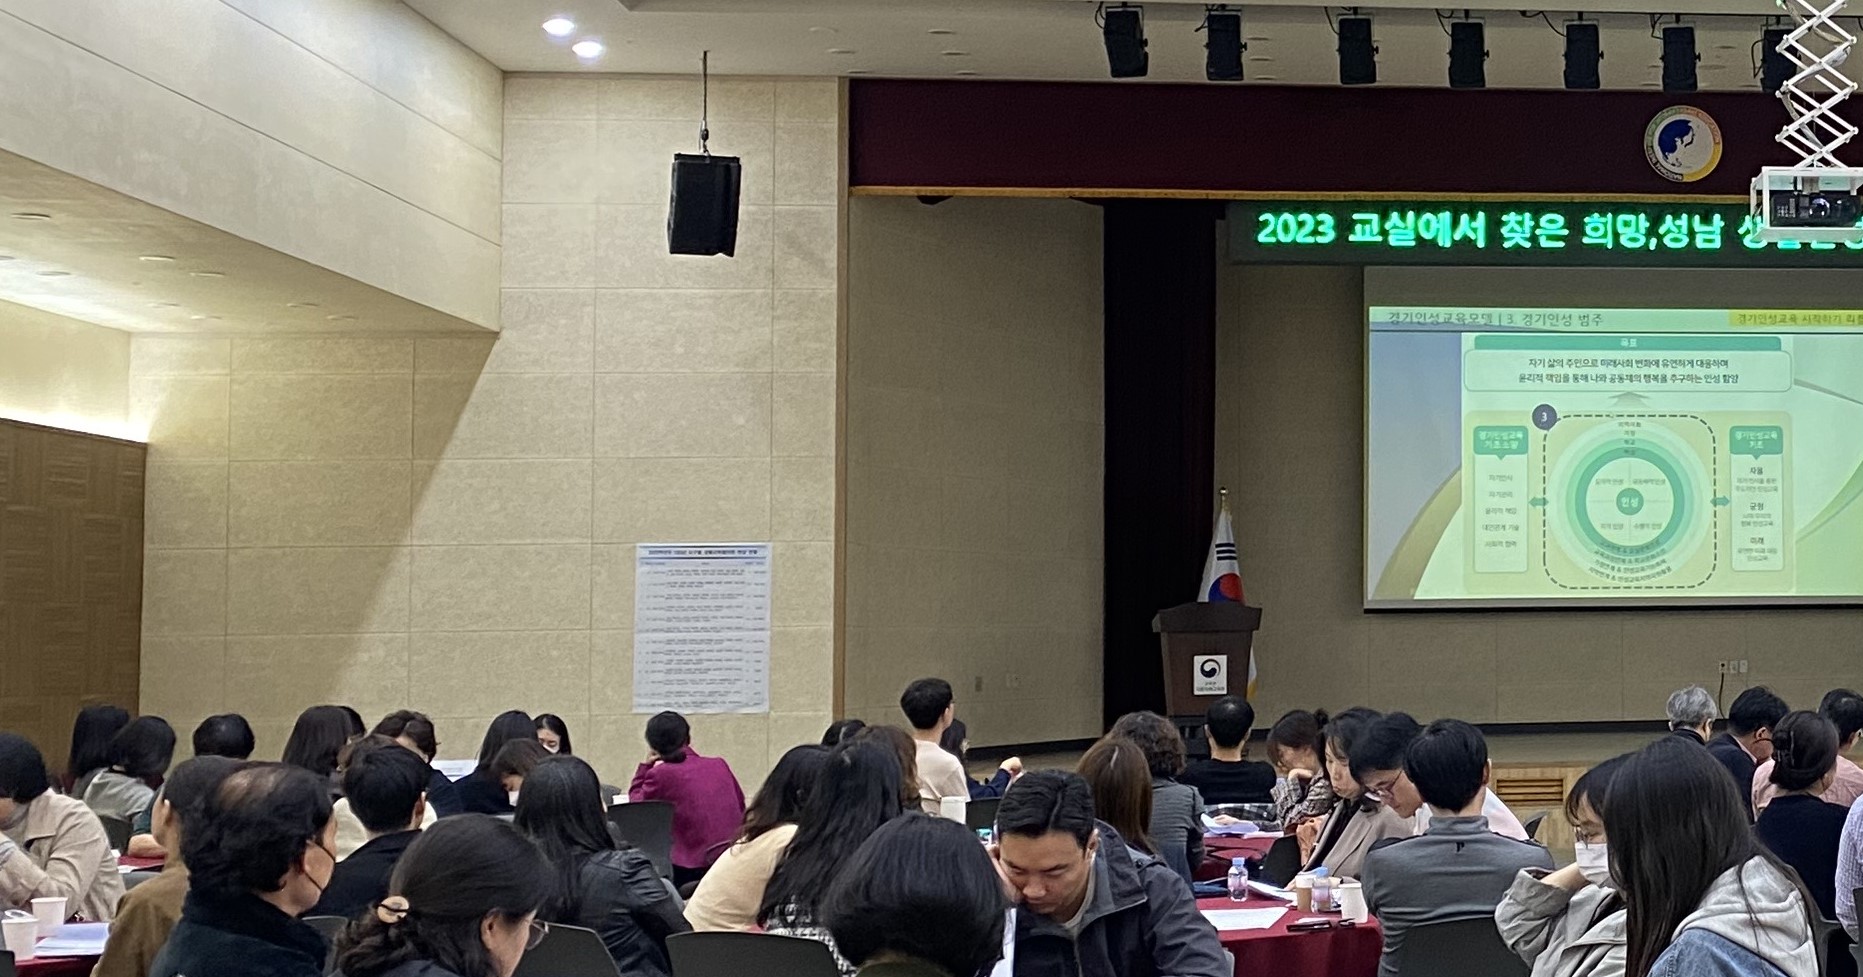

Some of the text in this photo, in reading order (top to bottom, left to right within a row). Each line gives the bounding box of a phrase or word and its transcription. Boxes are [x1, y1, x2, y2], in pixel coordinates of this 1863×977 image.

[1257, 212, 1335, 244] 2023
[1349, 210, 1486, 249] 교실에서
[1500, 211, 1570, 249] 찾은
[1582, 212, 1725, 250] 희망,성남
[1522, 313, 1573, 326] 경기인성
[1580, 313, 1603, 327] 범주
[1528, 358, 1546, 368] 자기
[1566, 358, 1599, 369] 주인으로
[1601, 358, 1634, 369] 미래사회
[1635, 358, 1660, 369] 변화에
[1661, 358, 1695, 369] 유연하게
[1590, 373, 1607, 384] 나와
[1704, 373, 1721, 384] 인성
[1541, 412, 1548, 422] 3
